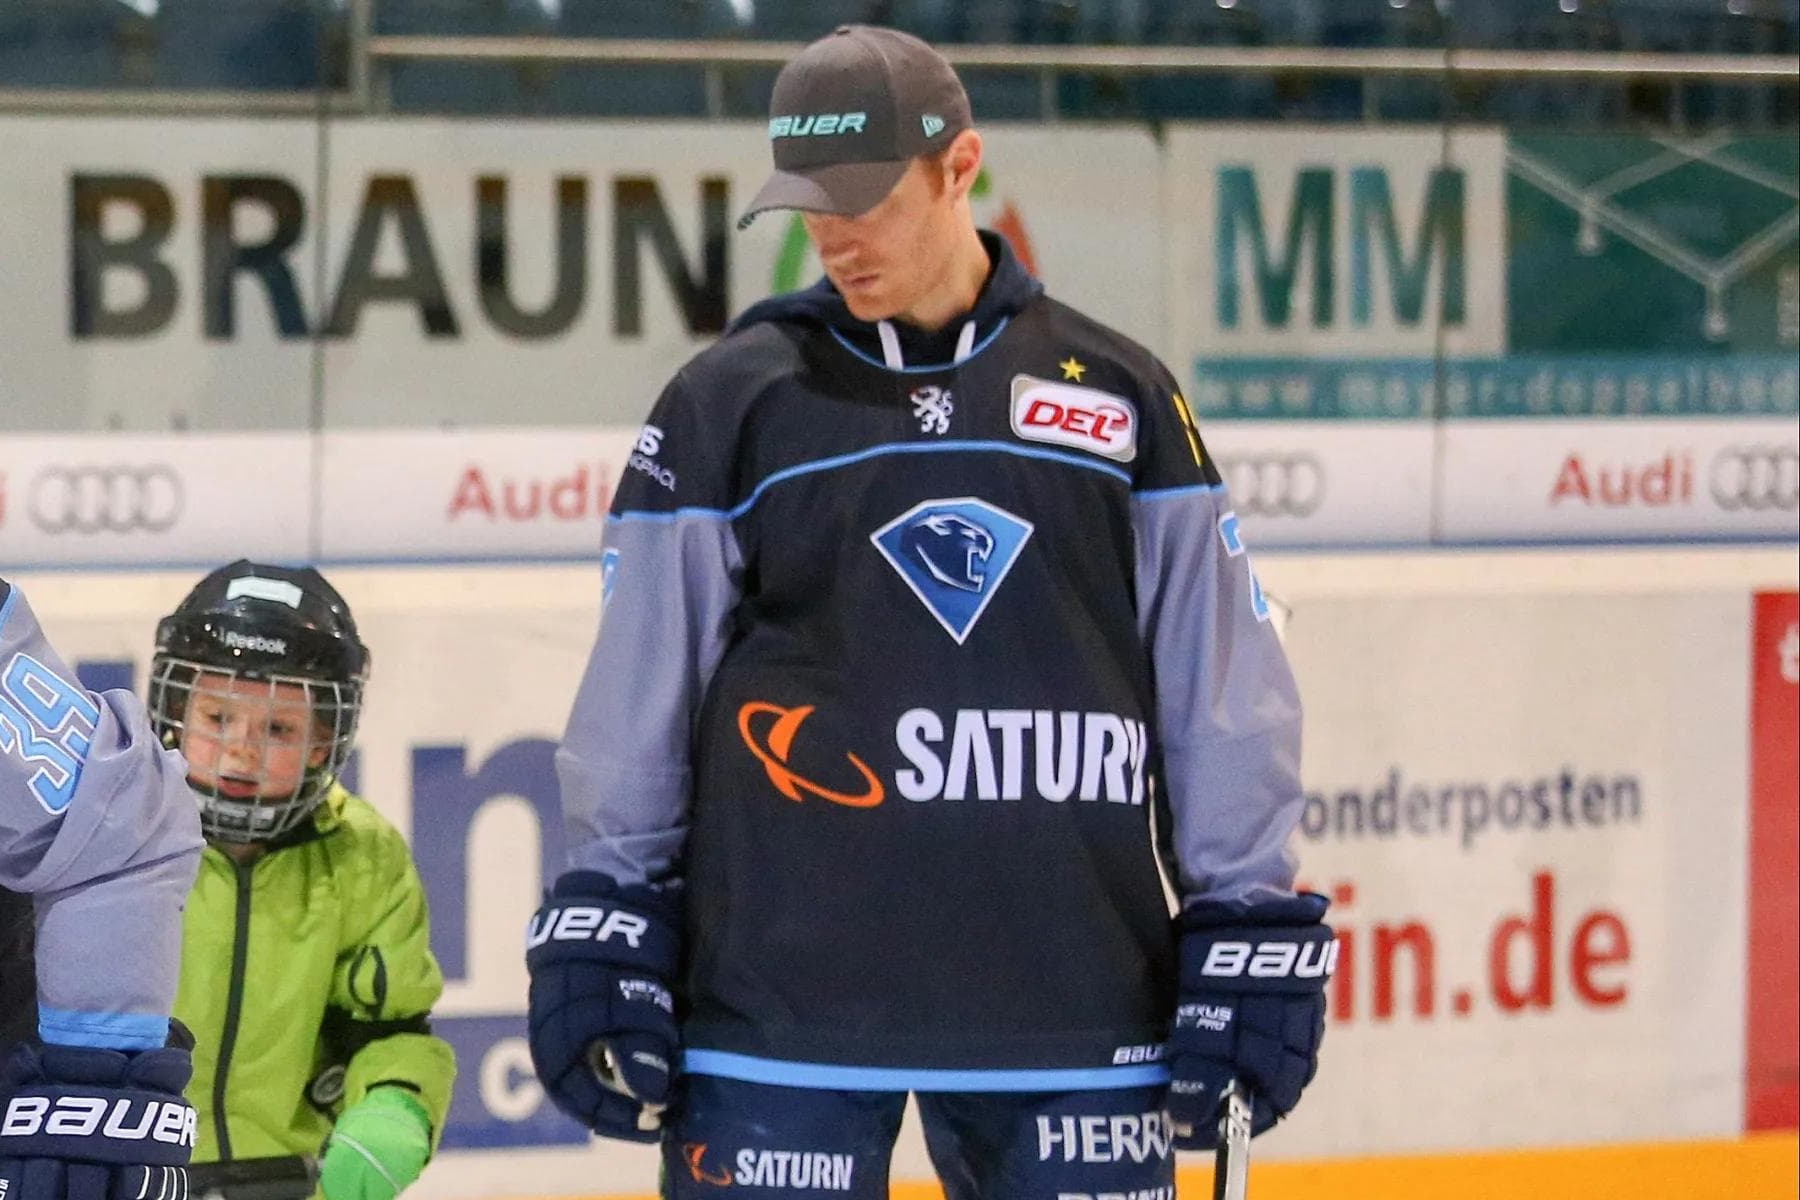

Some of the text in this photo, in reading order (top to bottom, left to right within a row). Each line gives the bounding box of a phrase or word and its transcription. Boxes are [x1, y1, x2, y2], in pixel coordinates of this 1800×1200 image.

[769, 112, 867, 139] AUER
[69, 171, 730, 342] BRAUN
[1214, 165, 1468, 329] MM
[1022, 399, 1114, 443] DEL
[449, 465, 611, 522] Audi
[1545, 454, 1695, 506] Audi
[225, 631, 288, 656] Reebok
[1301, 766, 1642, 848] onderposten
[1297, 870, 1631, 1024] in.de
[1, 1096, 197, 1148] BAUER
[735, 1149, 853, 1191] SATURN
